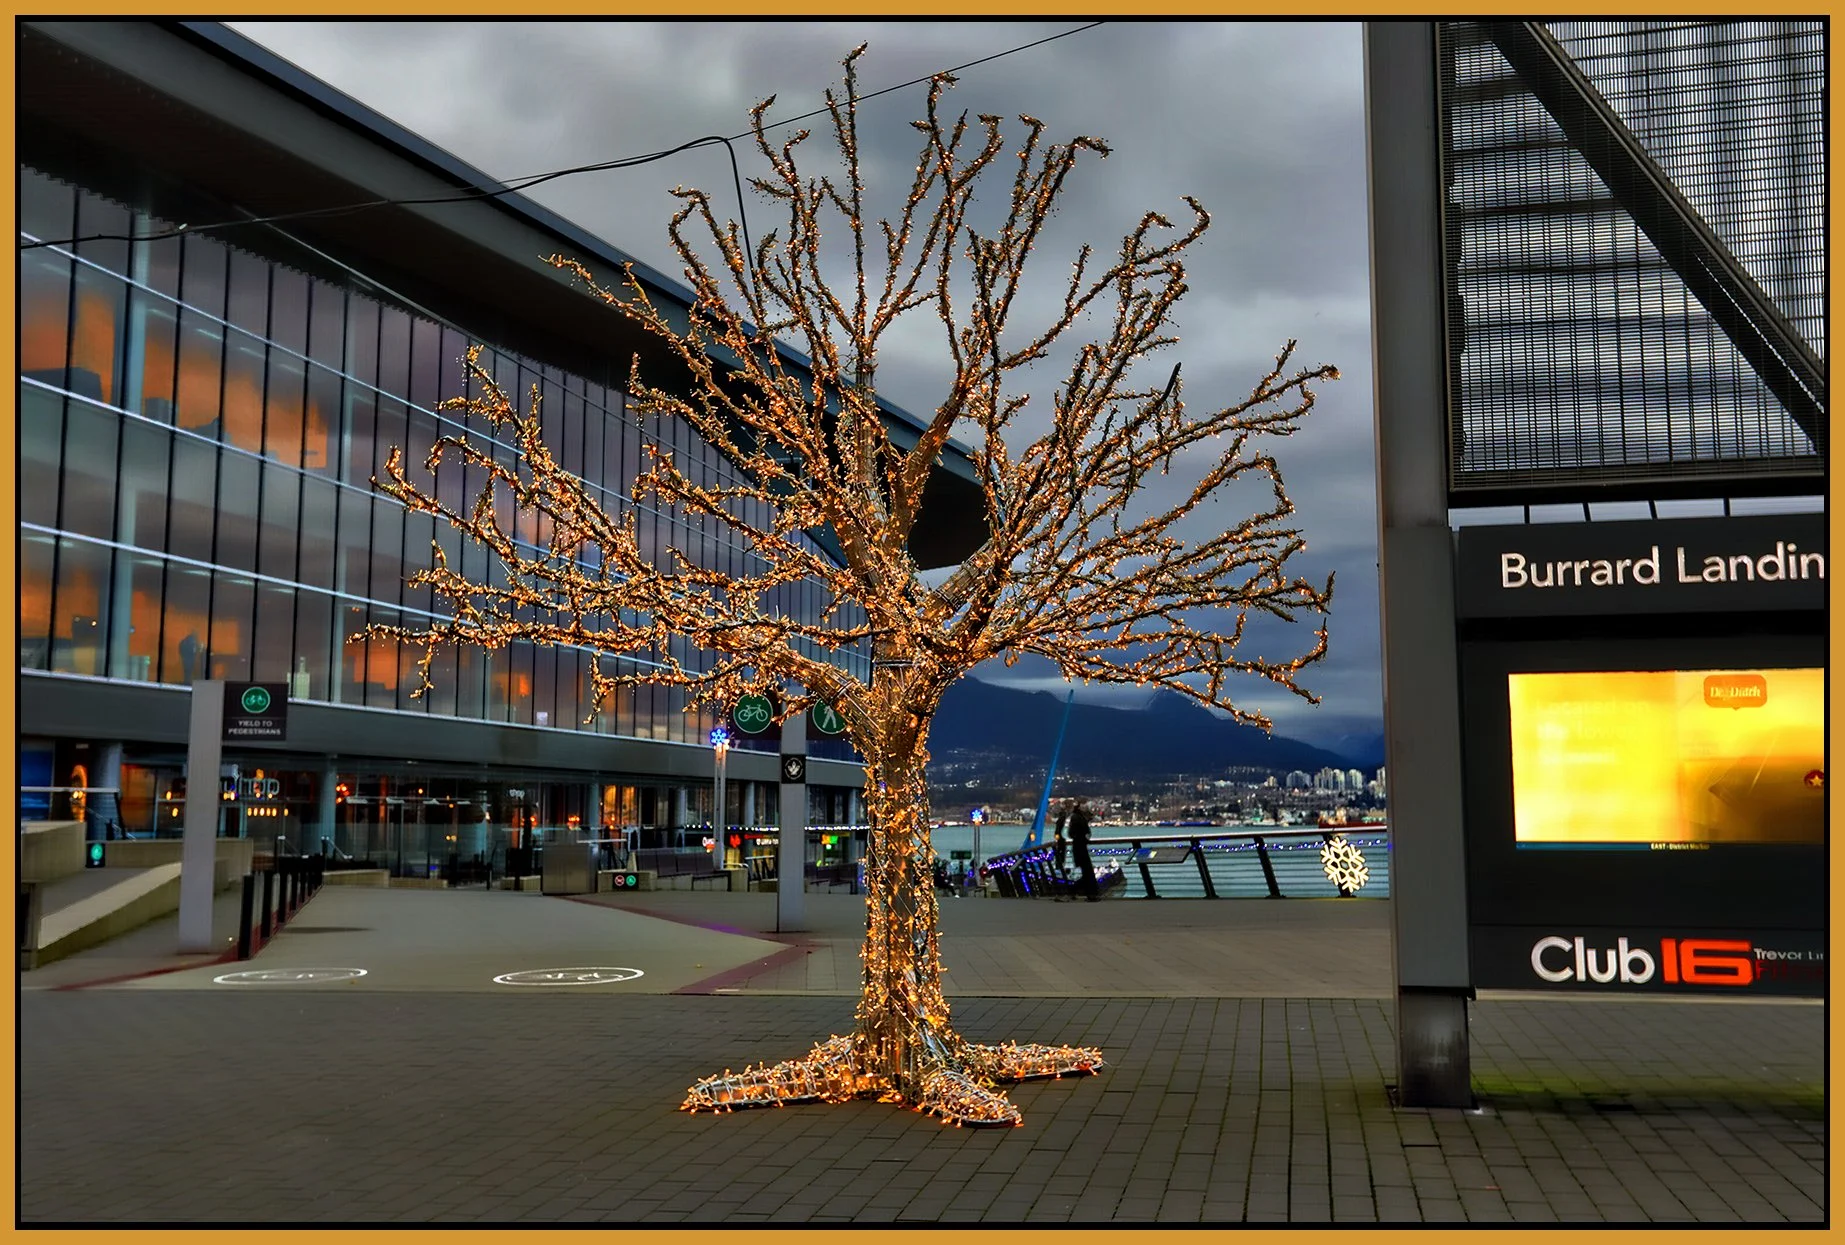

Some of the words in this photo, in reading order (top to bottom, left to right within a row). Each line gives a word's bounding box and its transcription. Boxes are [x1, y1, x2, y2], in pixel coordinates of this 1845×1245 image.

[1501, 545, 1660, 588] Burrard
[1531, 935, 1656, 984] Club
[1660, 937, 1754, 986] 16
